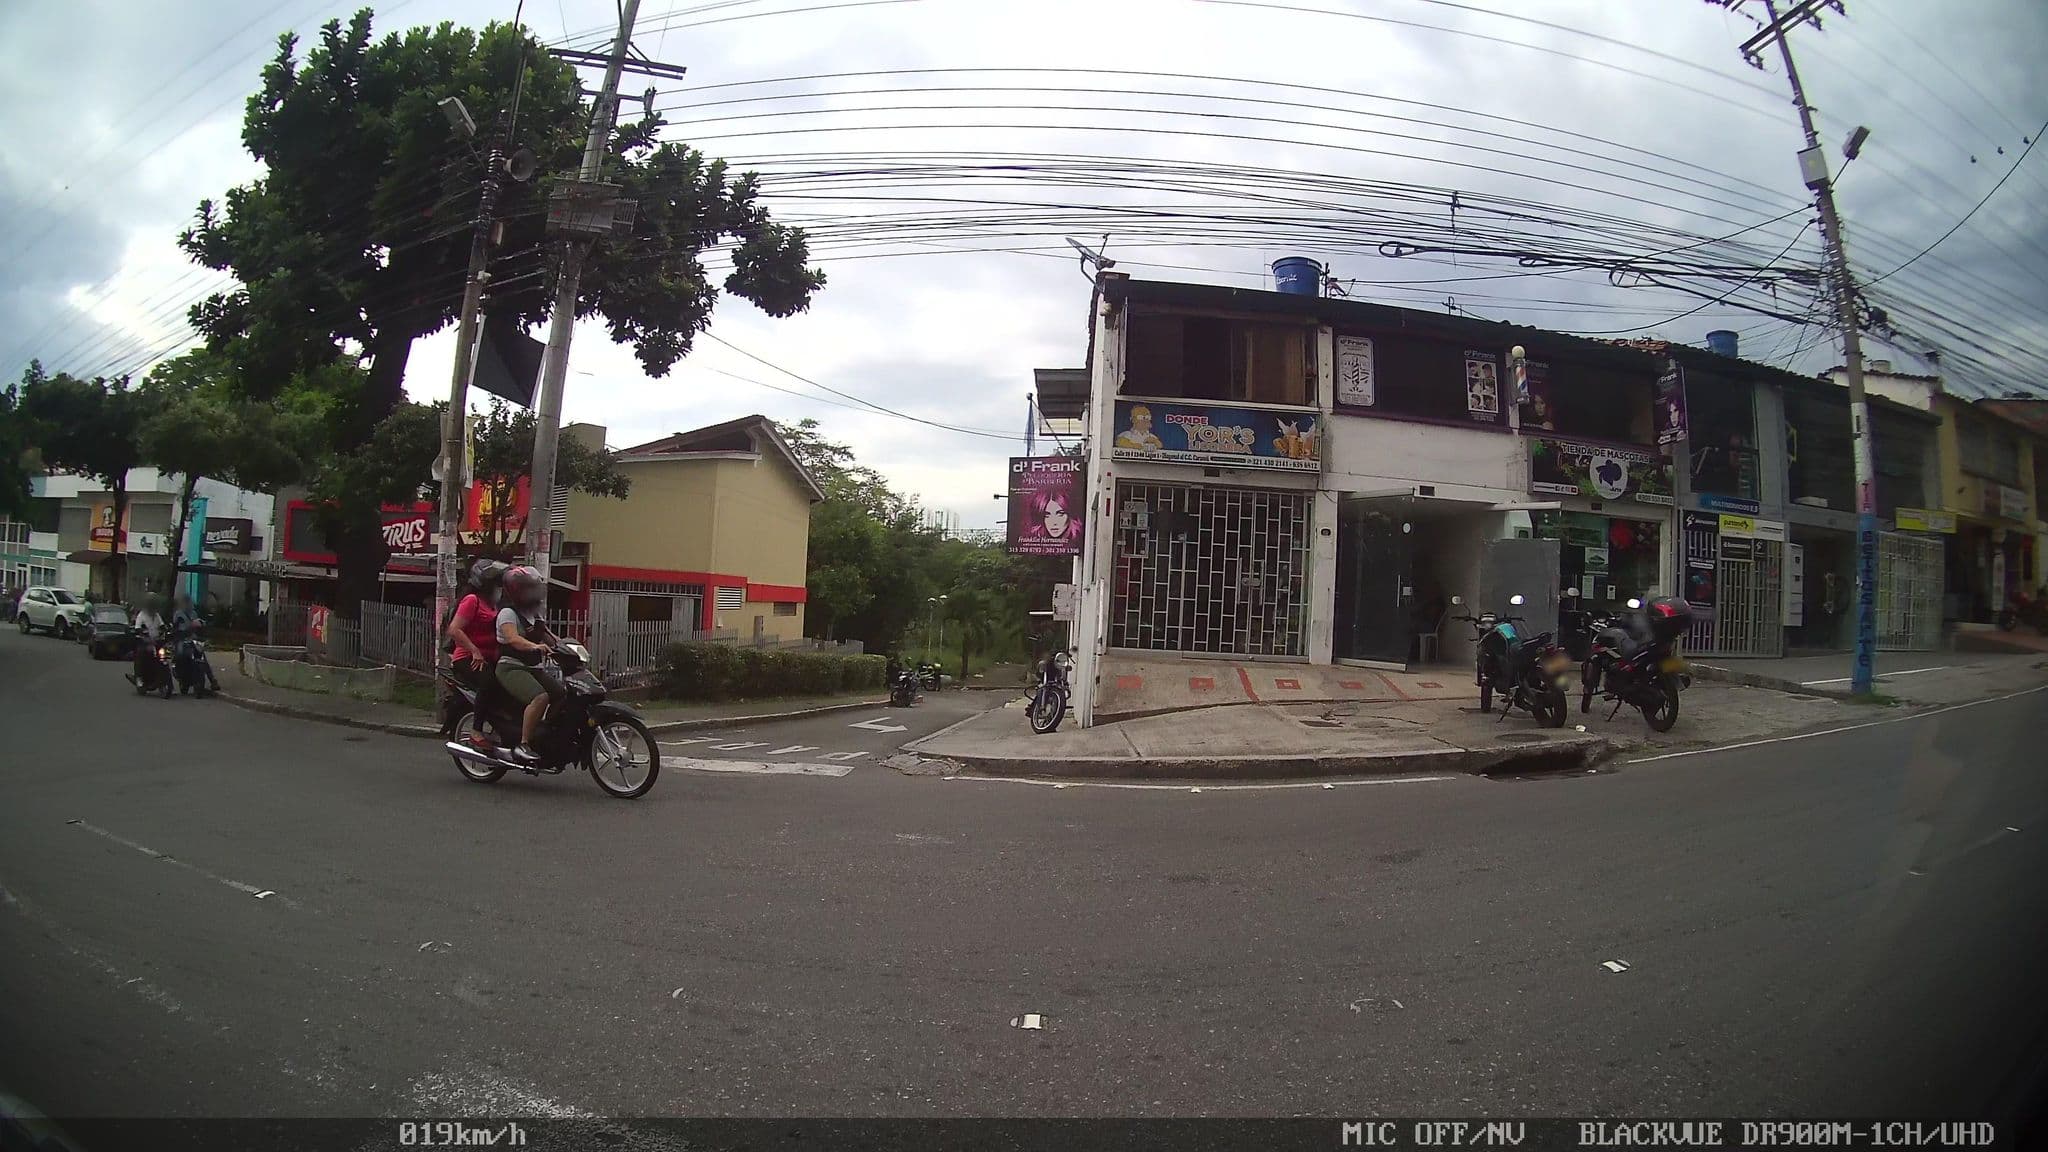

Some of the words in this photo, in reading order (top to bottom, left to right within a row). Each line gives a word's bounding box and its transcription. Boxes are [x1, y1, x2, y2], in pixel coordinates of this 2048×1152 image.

[1165, 414, 1209, 425] DONDE
[1181, 424, 1255, 445] YOR'S
[1561, 443, 1593, 456] TIENDA
[1594, 448, 1606, 457] DE
[1607, 450, 1650, 463] MASCOTAS
[1013, 461, 1028, 472] d'
[1031, 460, 1081, 472] Frank
